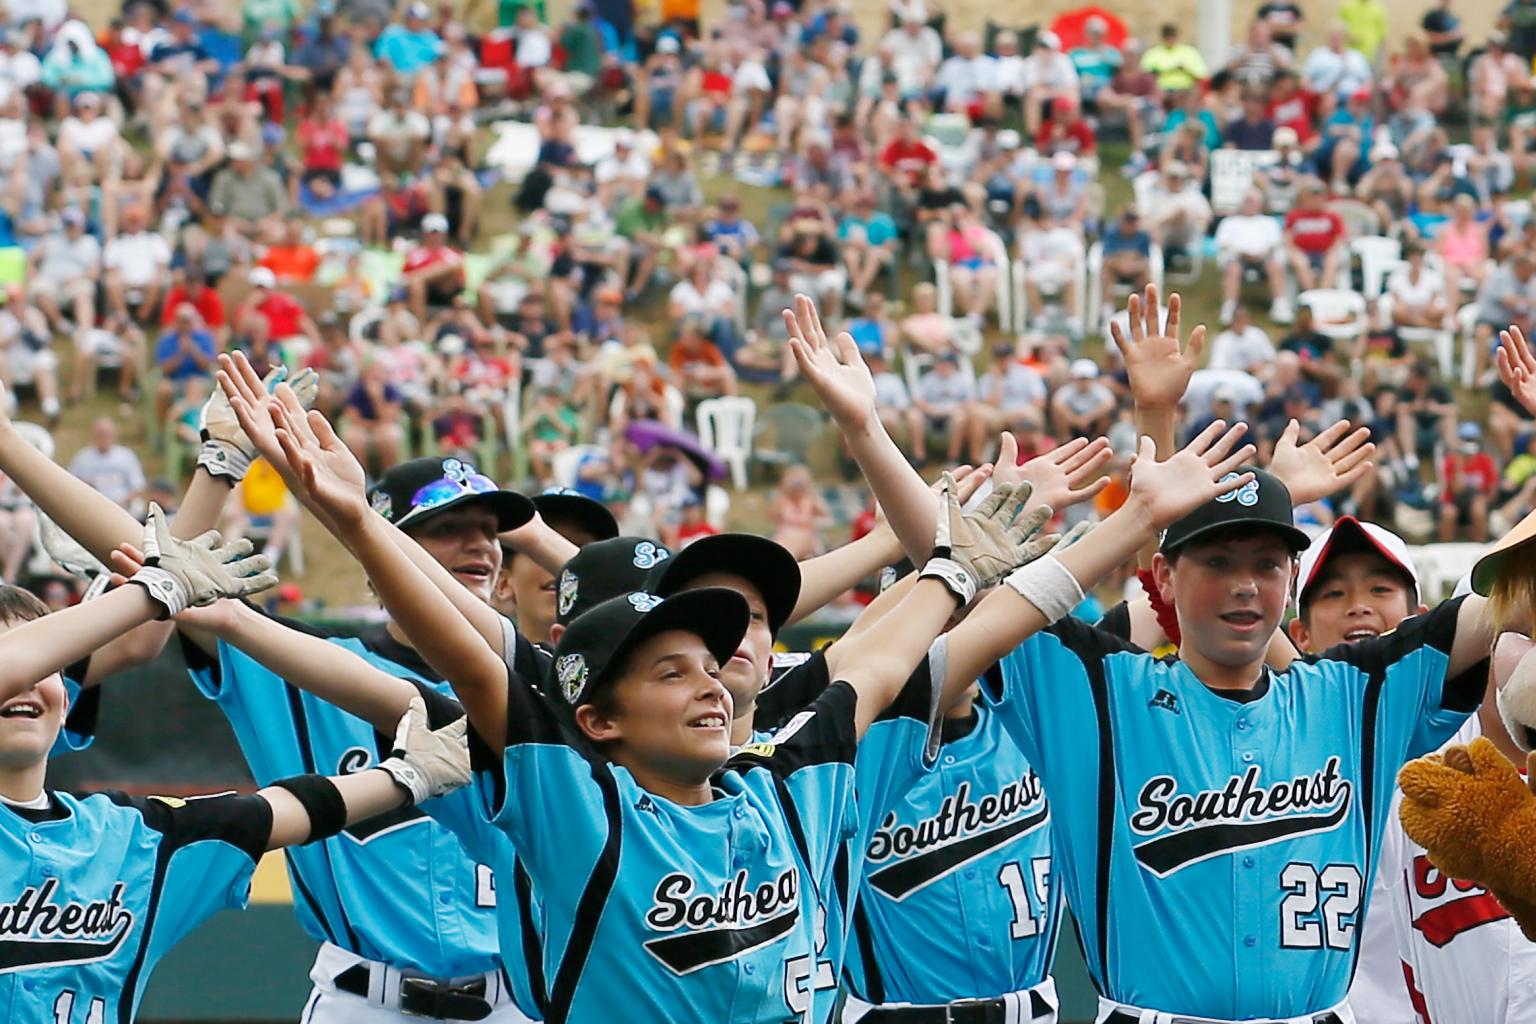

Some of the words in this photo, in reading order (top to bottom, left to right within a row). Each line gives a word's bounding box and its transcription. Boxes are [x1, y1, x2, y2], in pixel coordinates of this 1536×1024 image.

[866, 768, 1046, 863] Southeast
[1130, 755, 1352, 835] Southeast
[1279, 861, 1363, 951] 22
